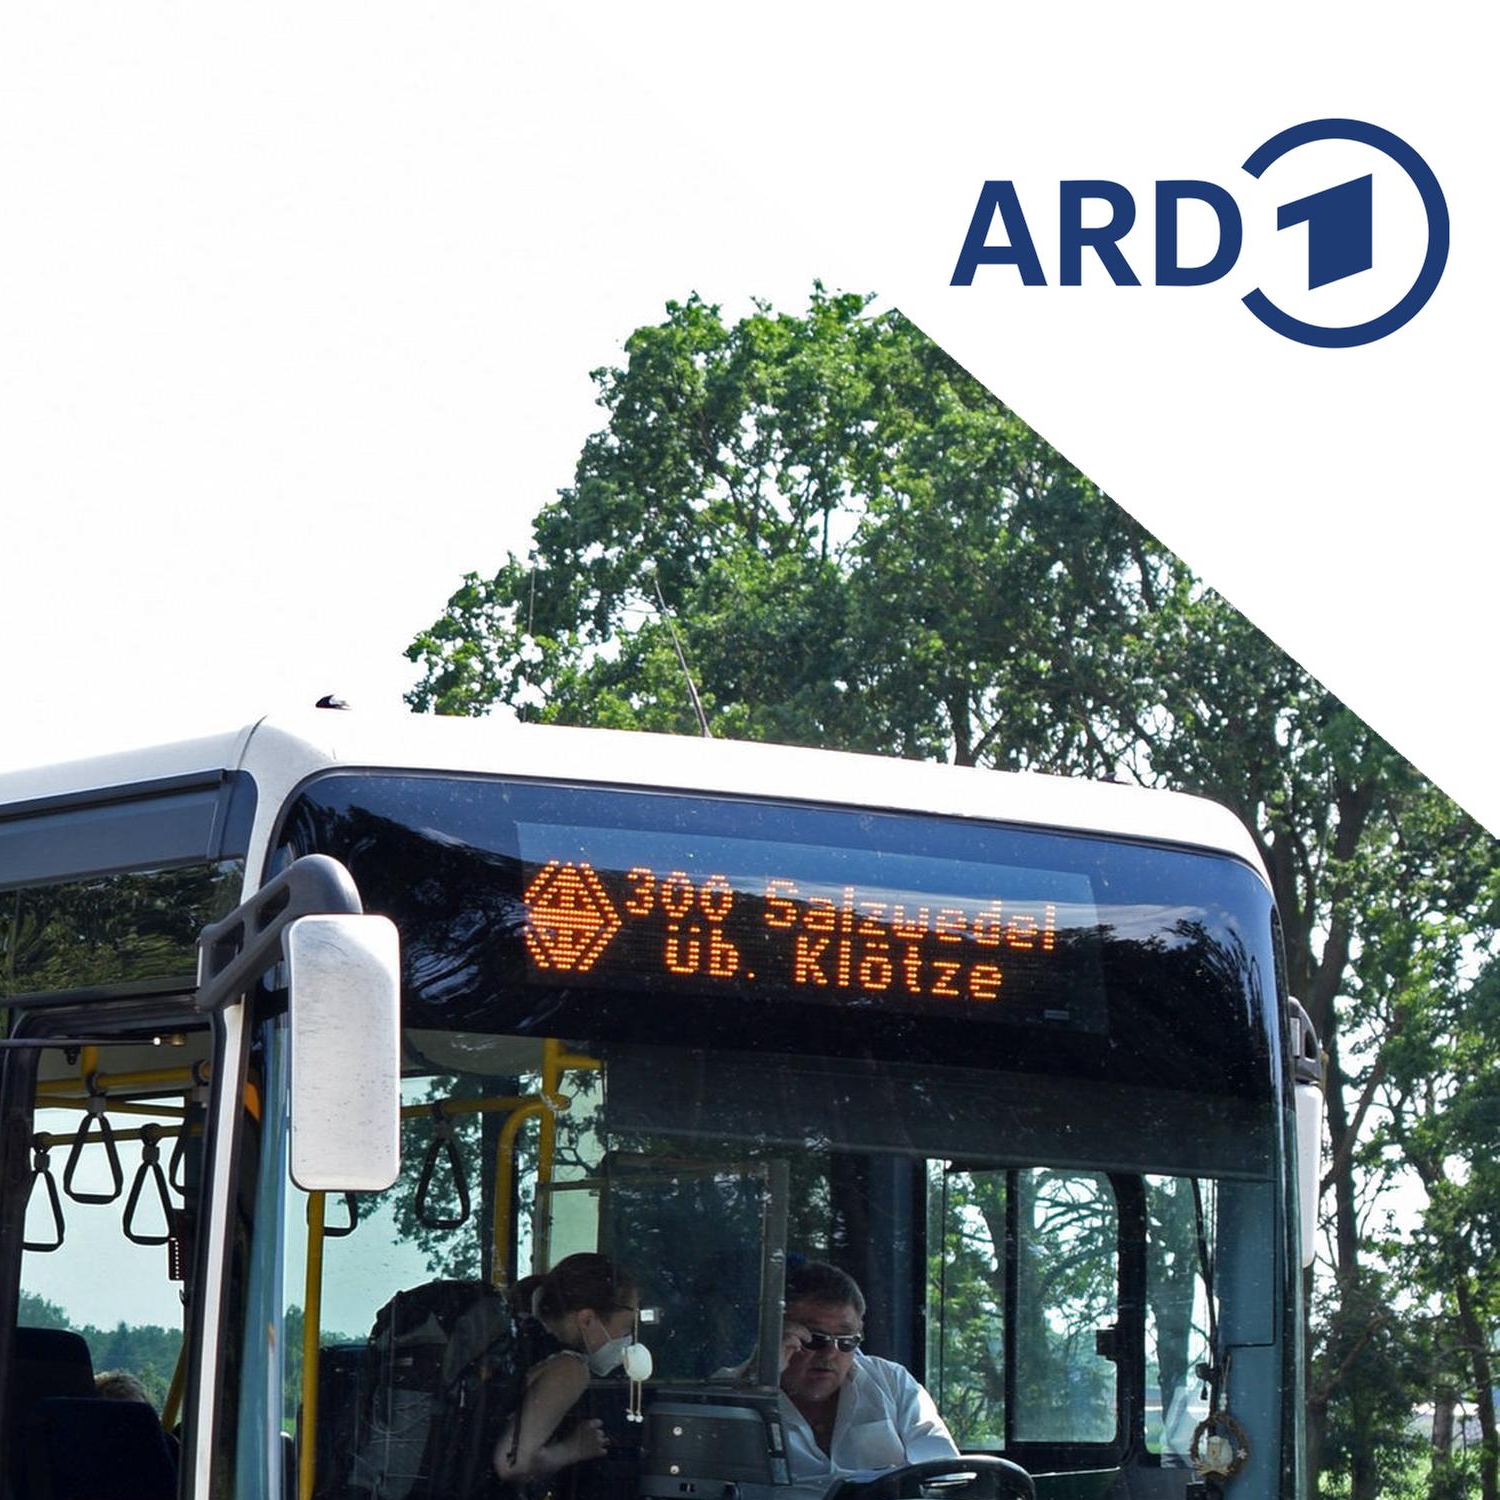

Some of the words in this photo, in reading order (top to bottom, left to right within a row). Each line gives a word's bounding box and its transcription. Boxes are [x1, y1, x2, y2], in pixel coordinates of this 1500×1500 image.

[625, 866, 736, 922] 300
[762, 879, 1058, 952] Salzwedel
[794, 935, 1003, 1000] Klötze
